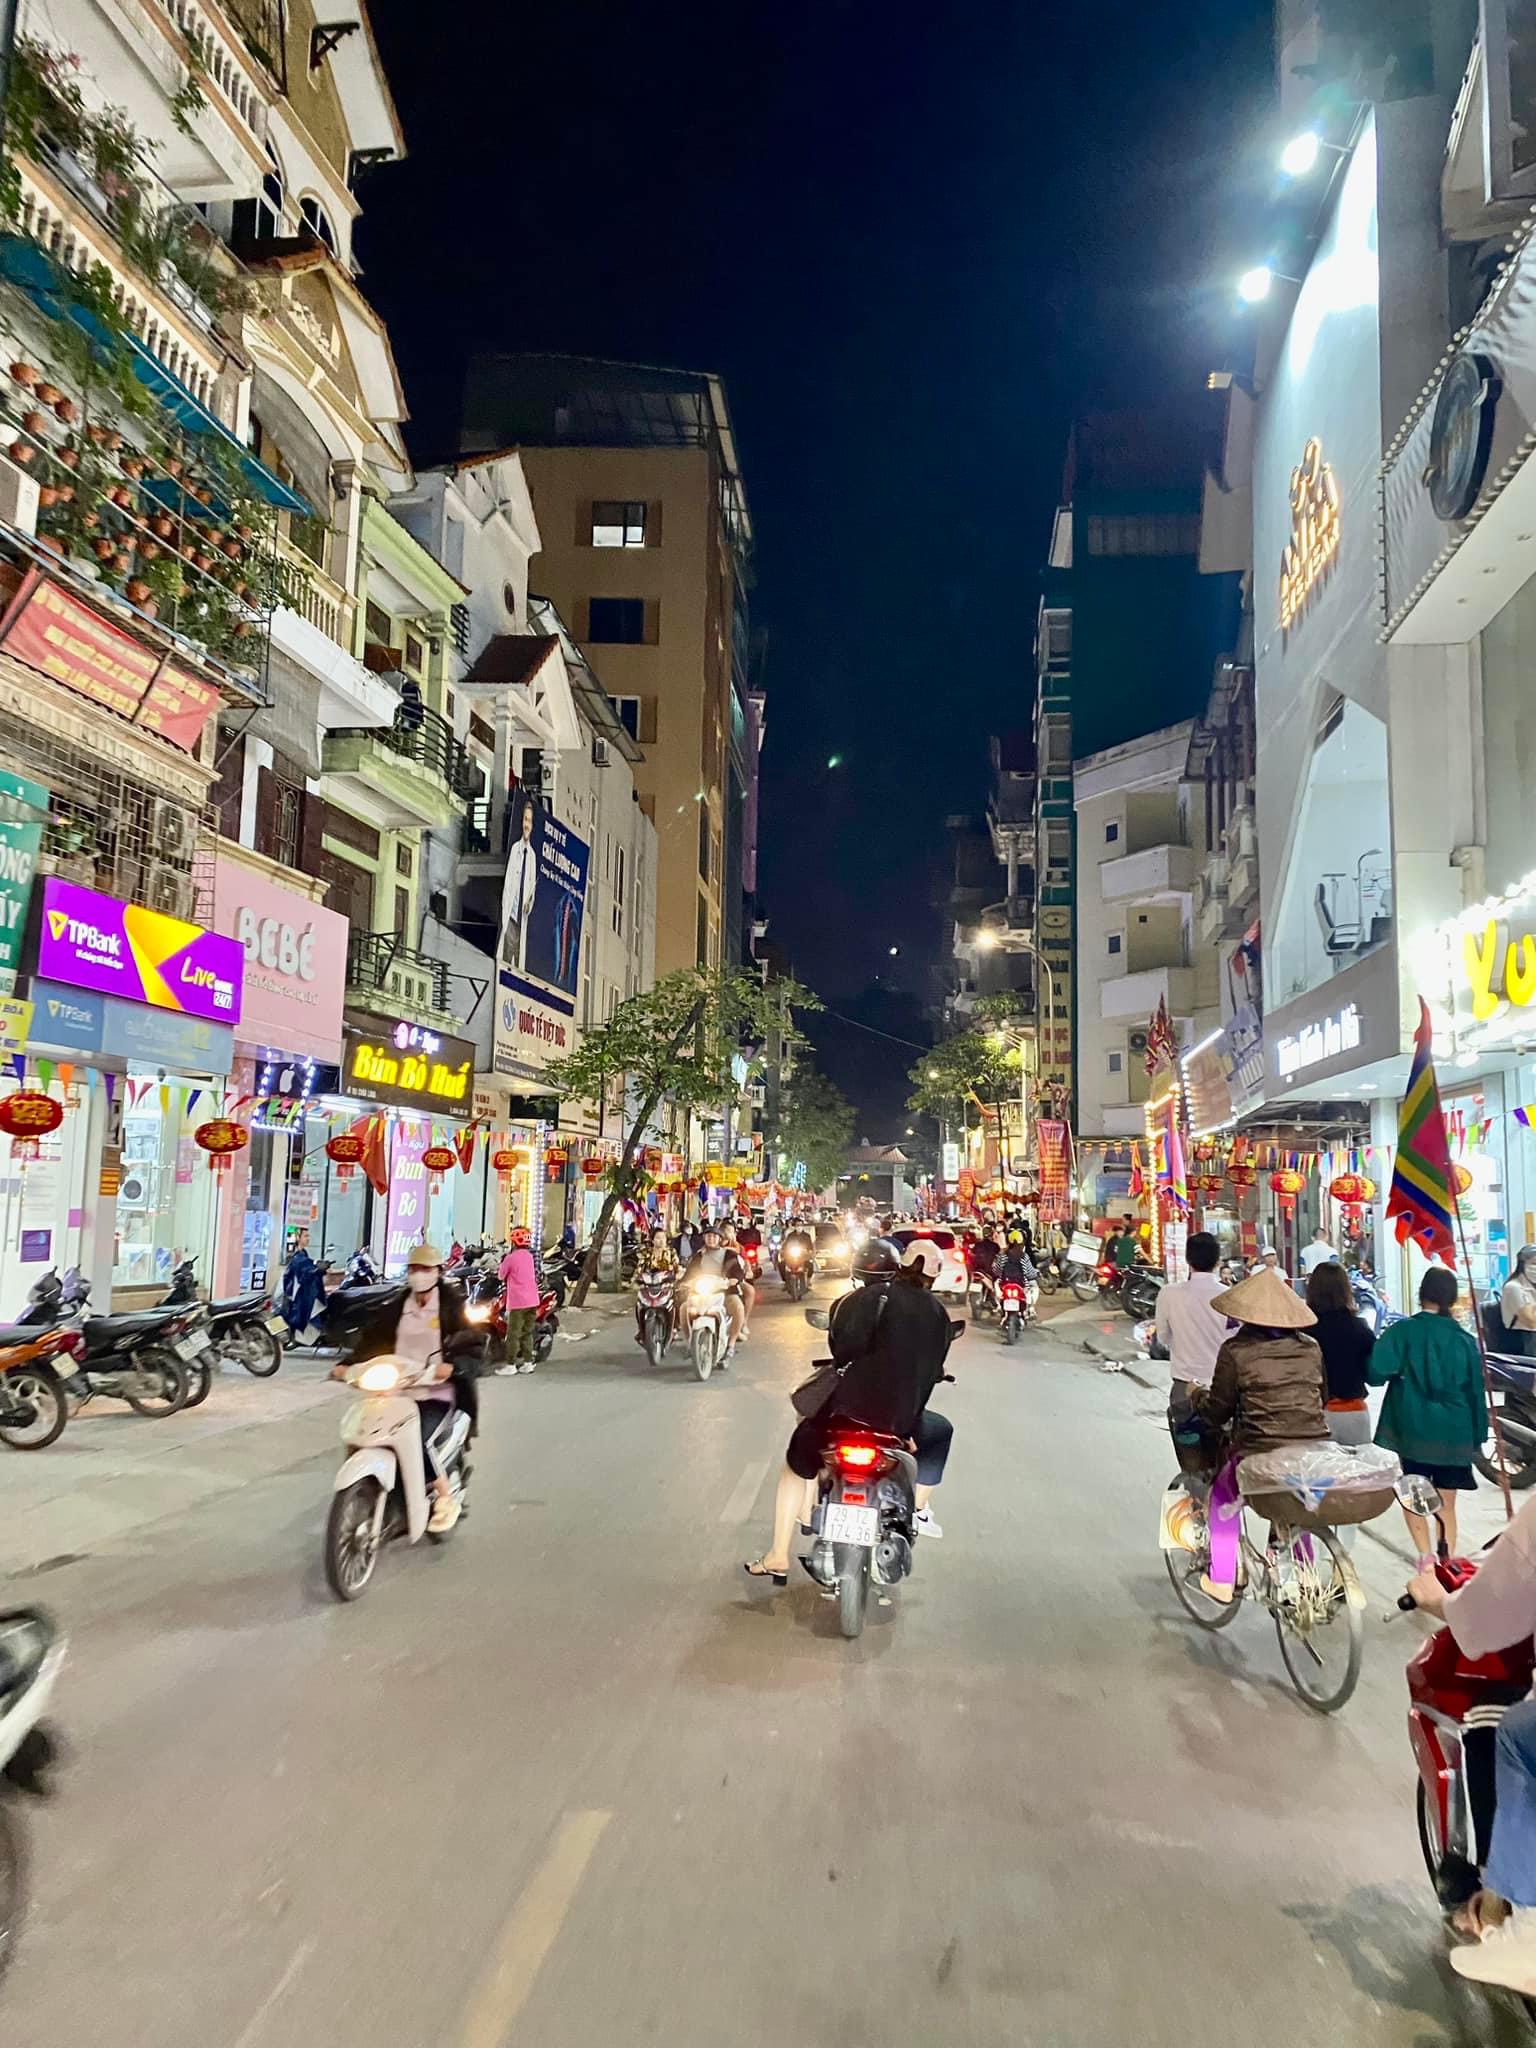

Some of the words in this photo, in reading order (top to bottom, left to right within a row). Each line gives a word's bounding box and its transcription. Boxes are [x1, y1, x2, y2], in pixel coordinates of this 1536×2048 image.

[67, 919, 122, 956] TPBank
[181, 956, 216, 989] Live
[519, 1006, 535, 1035] QUỐC
[536, 1011, 544, 1039] TẾ
[544, 1018, 555, 1047] VIỆT
[352, 1044, 398, 1084] Bún
[398, 1053, 428, 1090] Bò
[428, 1062, 471, 1099] Huế
[395, 1154, 423, 1180] Bún
[398, 1190, 417, 1216] Bò
[833, 1507, 848, 1522] 29
